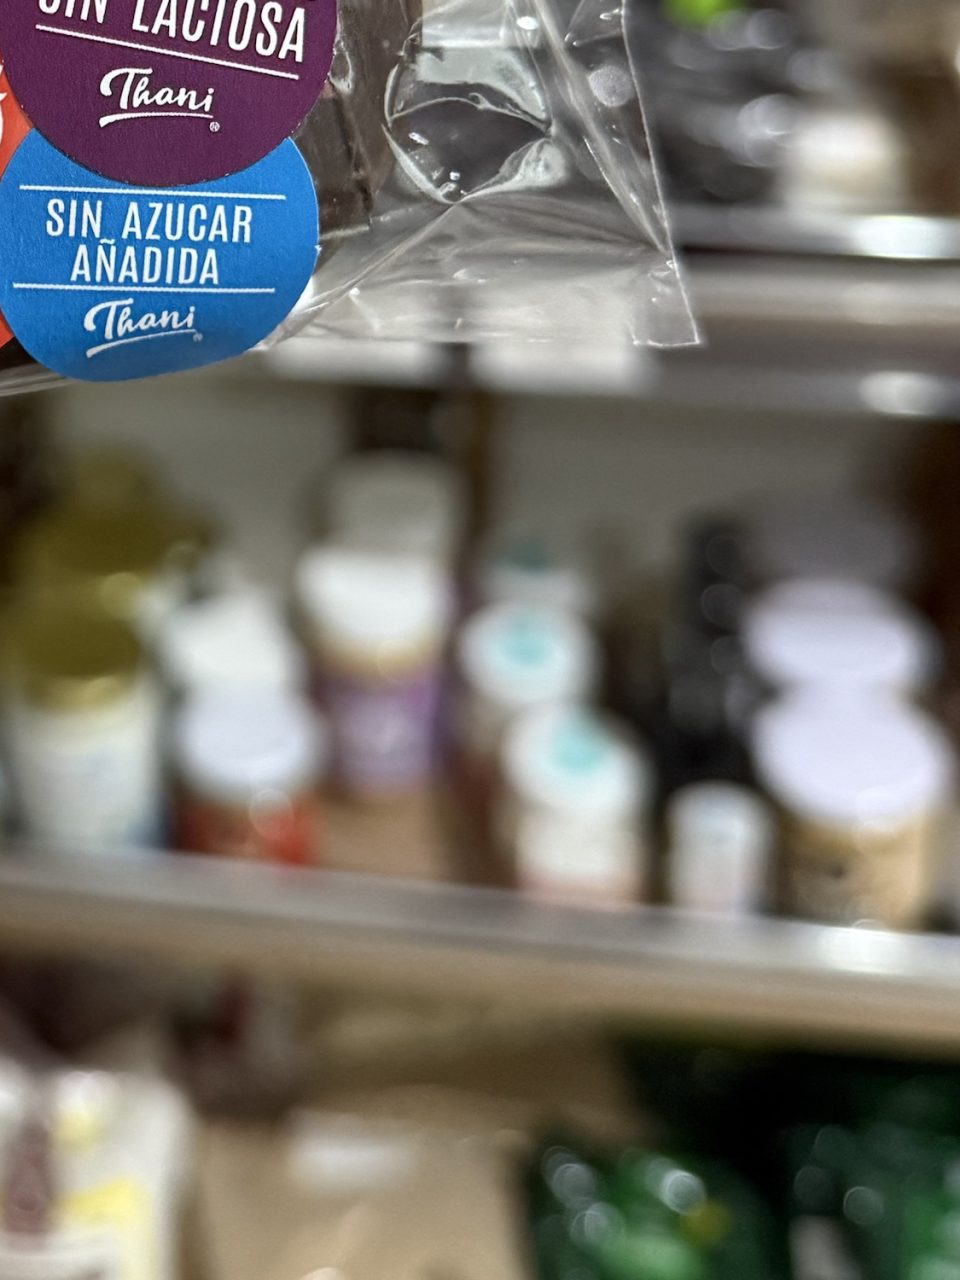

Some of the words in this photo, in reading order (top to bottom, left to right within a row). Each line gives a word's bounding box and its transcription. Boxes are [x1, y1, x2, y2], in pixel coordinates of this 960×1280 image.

[99, 67, 214, 112] Thani
[46, 198, 102, 238] SIN
[121, 201, 252, 243] AZUCAR
[70, 238, 219, 285] AÑADIDA
[83, 297, 196, 340] Thani
